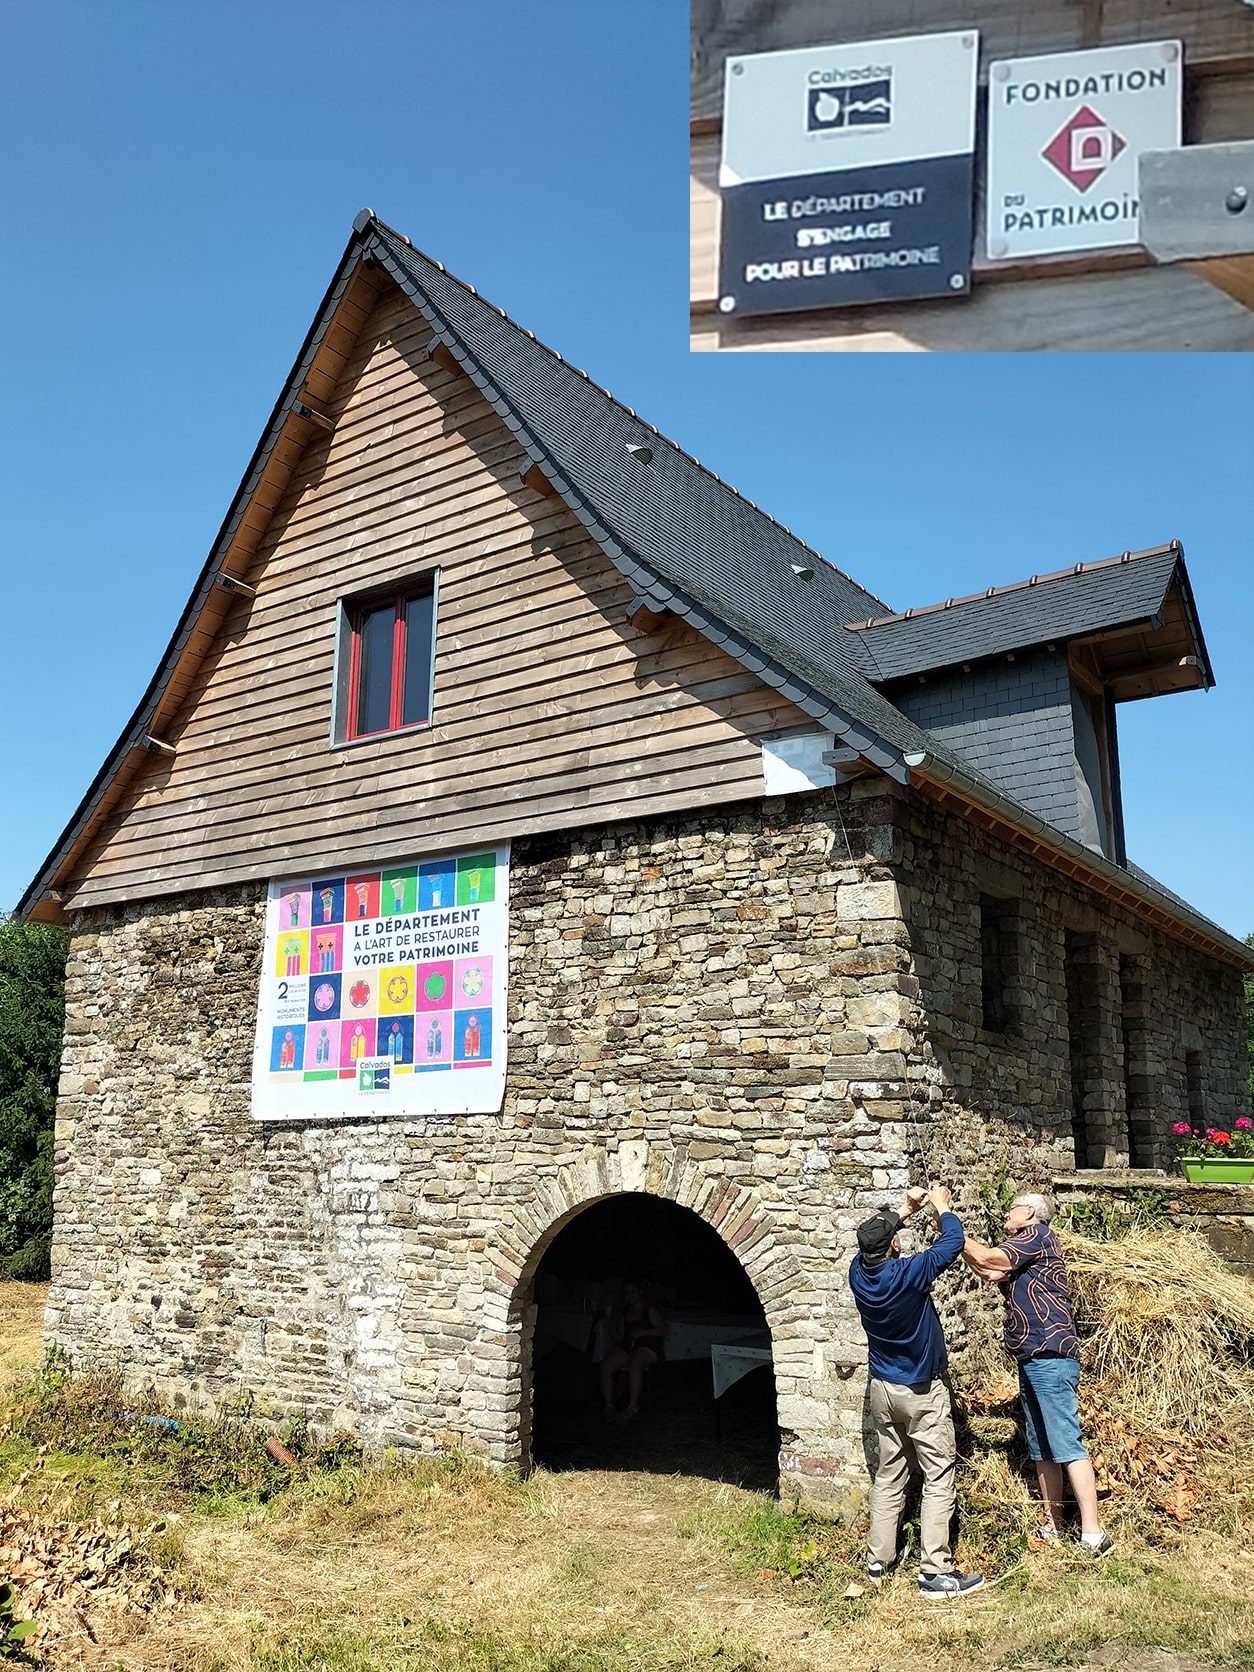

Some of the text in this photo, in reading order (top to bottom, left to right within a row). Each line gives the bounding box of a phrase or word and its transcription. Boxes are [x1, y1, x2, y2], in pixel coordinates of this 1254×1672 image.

[808, 64, 892, 84] Calvados
[1006, 68, 1166, 104] FONDATION
[764, 187, 925, 220] LE DÉPARTEMENT
[1004, 194, 1025, 207] DU
[796, 221, 891, 247] S'ENGAGE
[745, 246, 940, 283] POUR LE PATRIMOINE
[354, 908, 480, 937] LE DÉPARTEMENT
[354, 925, 480, 951] A L'ART DE RESTAURER
[354, 941, 479, 966] VOTRE PATRIMOINE
[278, 981, 288, 999] 2
[360, 1061, 391, 1069] Calvados
